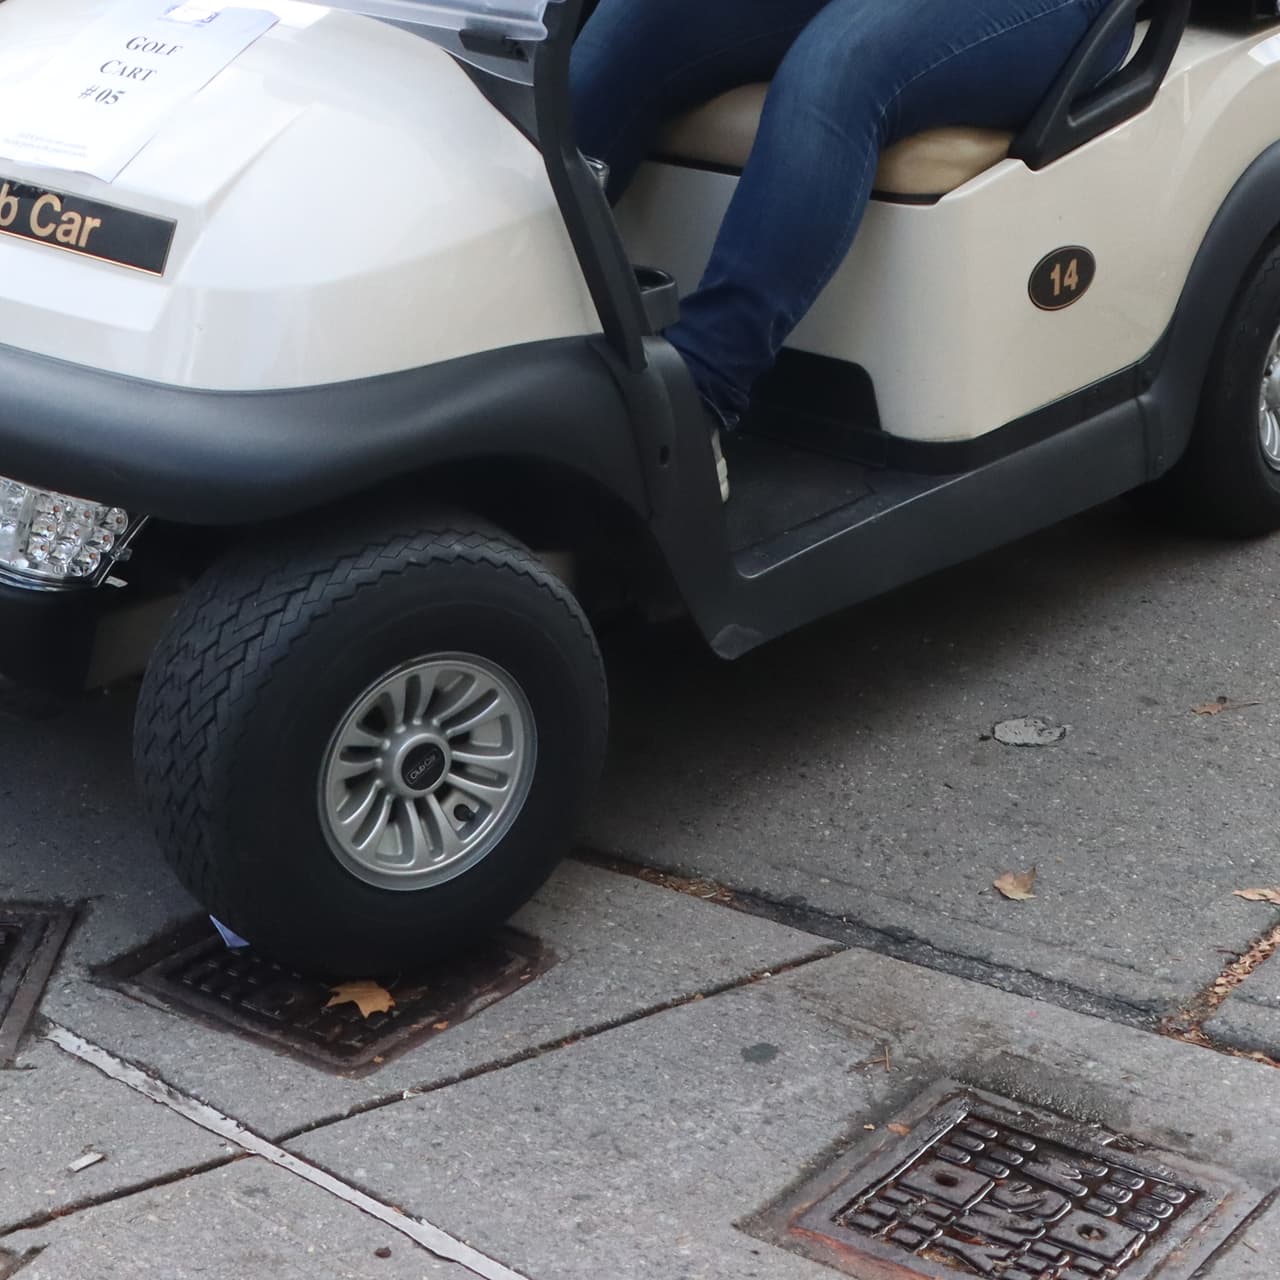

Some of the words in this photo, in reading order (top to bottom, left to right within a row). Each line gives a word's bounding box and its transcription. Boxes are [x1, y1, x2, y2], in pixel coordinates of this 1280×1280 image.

[125, 35, 183, 56] GOLF
[99, 59, 157, 82] CART
[30, 193, 101, 248] Car
[1050, 257, 1079, 297] 14
